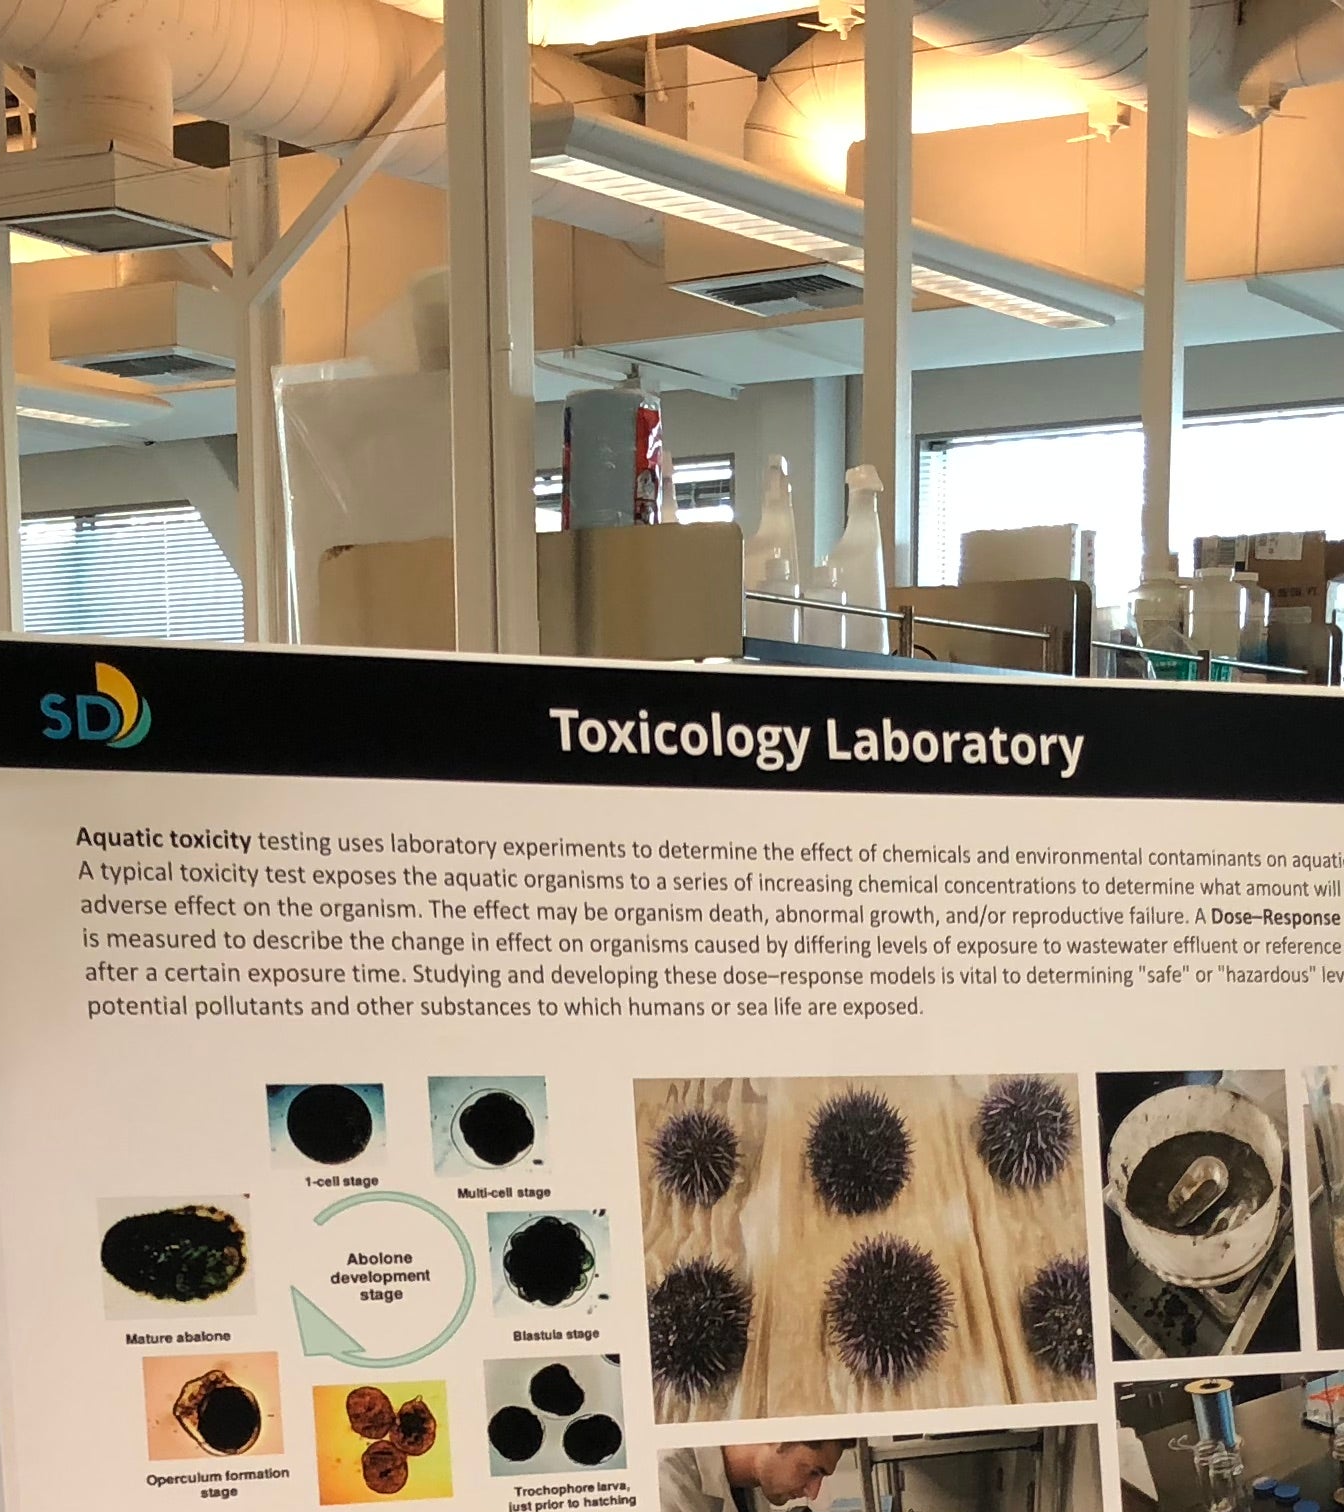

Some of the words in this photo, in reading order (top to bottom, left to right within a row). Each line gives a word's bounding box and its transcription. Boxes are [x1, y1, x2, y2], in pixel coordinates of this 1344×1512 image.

[39, 692, 121, 741] SD
[548, 707, 812, 772] Toxicology
[825, 717, 1085, 779] Laboratory
[75, 826, 164, 852] Aquatic
[168, 828, 252, 855] toxicity
[257, 831, 332, 857] testing
[337, 836, 385, 853] uses
[389, 831, 498, 860] laboratory
[502, 837, 627, 861] experiments
[630, 840, 653, 859] to
[657, 838, 758, 861] determine
[762, 841, 795, 862] the
[799, 841, 853, 862] effect
[857, 842, 878, 863] of
[881, 843, 971, 864] chemicals
[975, 844, 1010, 865] and
[1014, 845, 1143, 866] environmental
[1147, 849, 1262, 868] contaminants
[1265, 853, 1288, 868] on
[77, 859, 95, 881] A
[99, 860, 173, 886] typical
[179, 862, 259, 888] toxicity
[264, 865, 307, 884] test
[311, 868, 397, 889] exposes
[401, 864, 438, 887] the
[443, 868, 518, 892] aquatic
[522, 869, 625, 893] organisms
[629, 871, 651, 891] to
[655, 875, 667, 891] a
[672, 871, 729, 892] series
[733, 871, 754, 892] of
[758, 872, 854, 898] increasing
[857, 873, 939, 894] chemical
[943, 876, 1077, 895] concentrations
[1081, 878, 1101, 895] to
[1104, 876, 1195, 896] determine
[1198, 876, 1242, 897] what
[1245, 880, 1310, 898] amount
[1312, 878, 1342, 898] will
[80, 892, 167, 915] adverse
[173, 894, 237, 917] effect
[242, 900, 271, 917] on
[277, 895, 313, 918] the
[318, 897, 423, 923] organism.
[427, 898, 467, 920] The
[472, 898, 531, 921] effect
[536, 905, 578, 925] may
[583, 900, 609, 922] be
[613, 902, 703, 927] organism
[708, 902, 769, 926] death,
[774, 903, 864, 924] abnormal
[869, 904, 940, 928] growth,
[945, 903, 1007, 928] and/or
[1011, 905, 1124, 929] reproductive
[1128, 905, 1190, 925] failure.
[1193, 906, 1207, 925] A
[82, 927, 100, 948] is
[106, 927, 217, 950] measured
[223, 930, 246, 950] to
[252, 928, 343, 951] describe
[348, 929, 385, 951] the
[390, 930, 465, 956] change
[470, 931, 490, 952] in
[495, 931, 553, 953] effect
[557, 937, 584, 953] on
[589, 934, 689, 958] organisms
[693, 934, 760, 954] caused
[765, 933, 789, 959] by
[793, 933, 872, 959] differing
[876, 934, 928, 955] levels
[932, 934, 952, 955] of
[955, 939, 1038, 959] exposure
[1042, 937, 1062, 955] to
[1065, 937, 1169, 955] wastewater
[1172, 934, 1239, 954] effluent
[1242, 939, 1261, 955] or
[1264, 935, 1342, 955] reference
[304, 1175, 341, 1188] 1-cell
[341, 1175, 380, 1189] stage
[456, 1186, 514, 1200] Multi-cell
[516, 1186, 552, 1201] stage
[346, 1251, 414, 1266] Abolone
[329, 1268, 431, 1287] development
[359, 1288, 404, 1304] stage
[124, 1332, 174, 1345] Mature
[175, 1330, 232, 1344] abalone
[512, 1328, 563, 1343] Blastula
[565, 1328, 600, 1342] stage
[145, 1471, 223, 1488] Operculum
[224, 1467, 291, 1482] formation
[199, 1486, 239, 1500] stage
[512, 1482, 596, 1498] Trochophore
[596, 1481, 631, 1492] larva,
[566, 1498, 581, 1509] to
[582, 1494, 637, 1508] hatching
